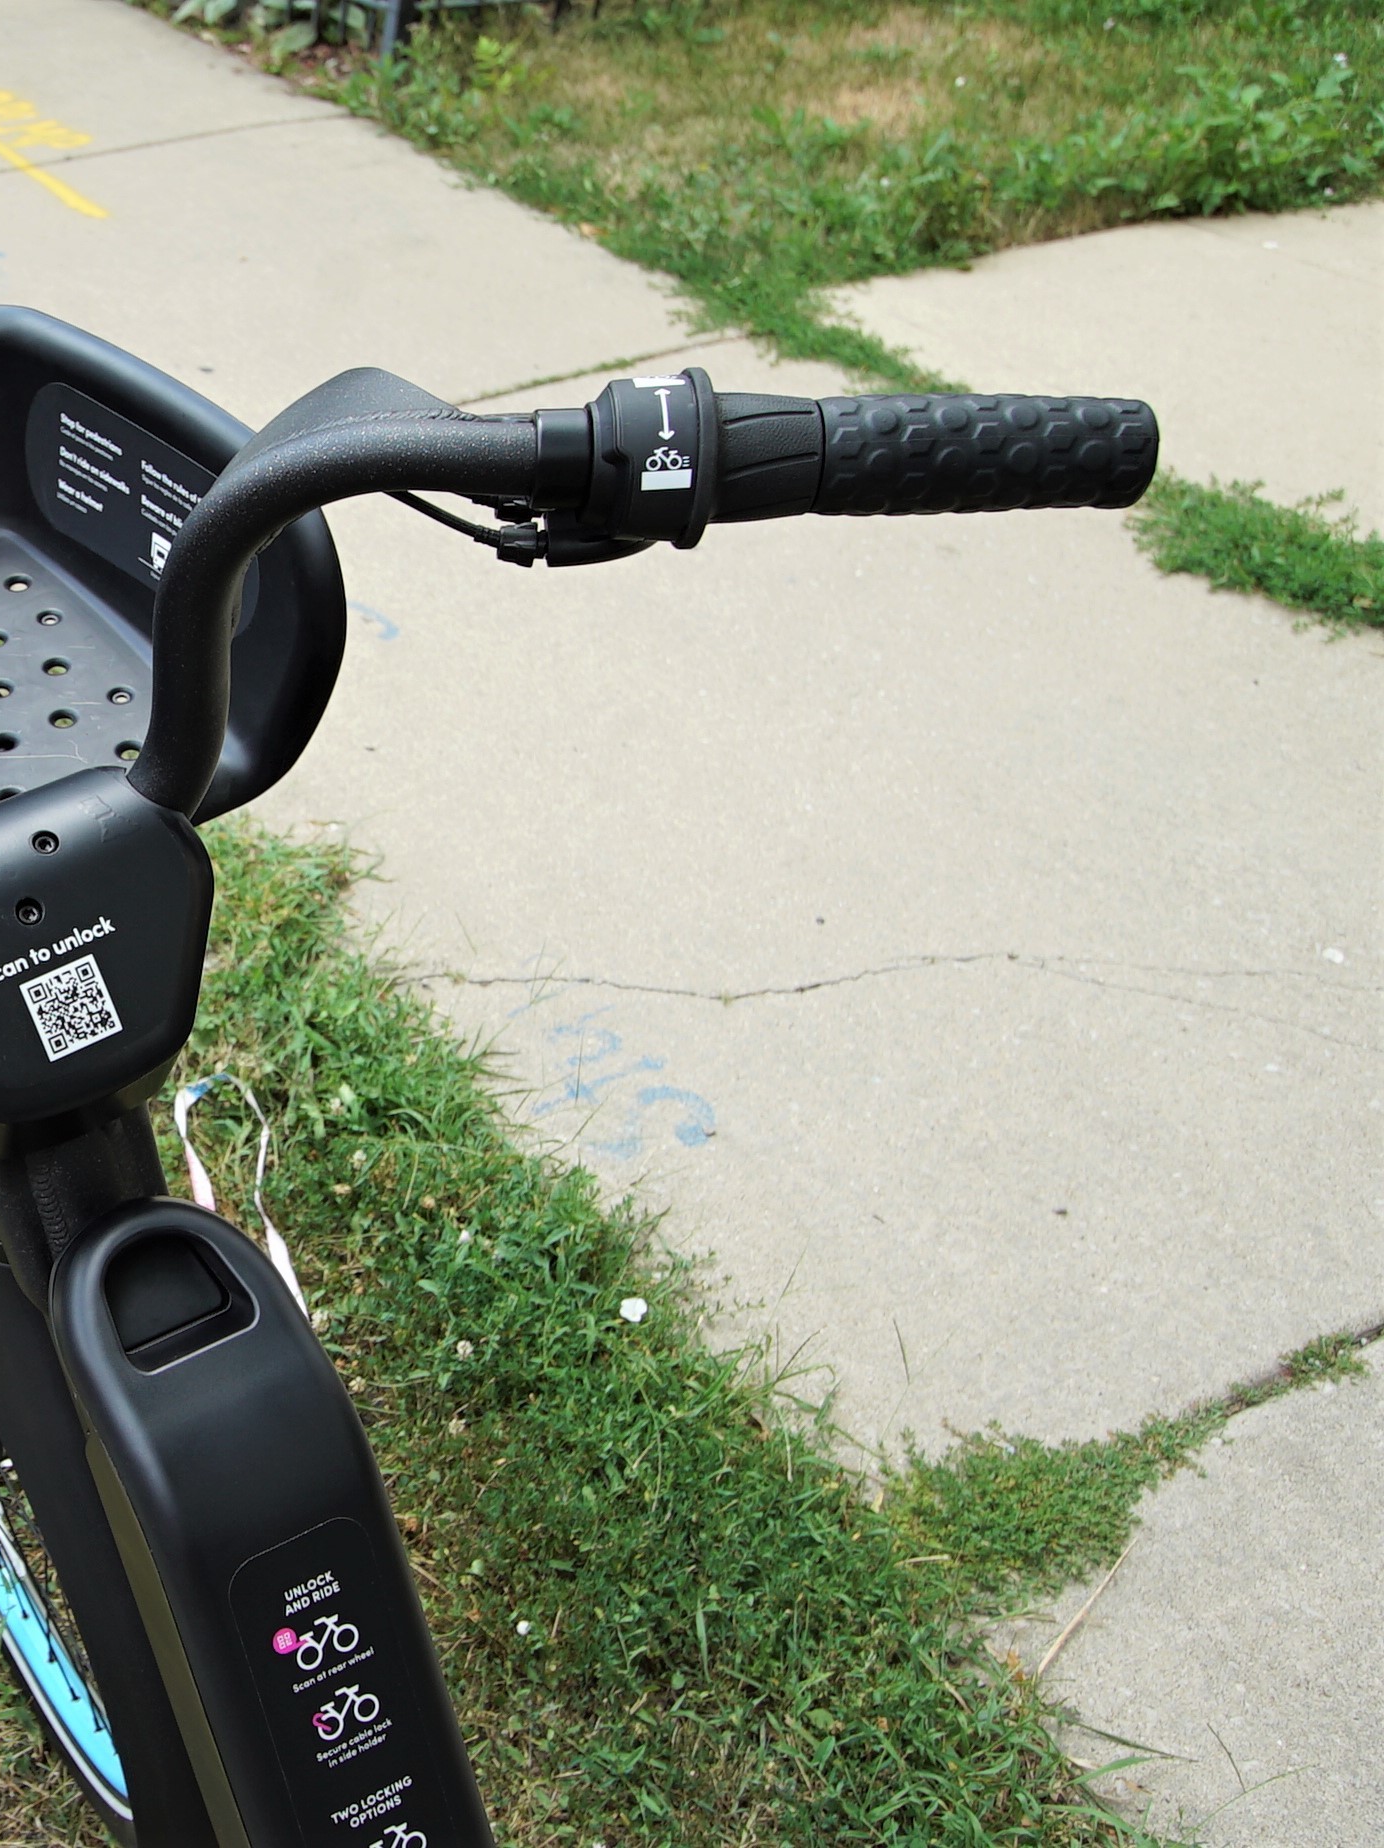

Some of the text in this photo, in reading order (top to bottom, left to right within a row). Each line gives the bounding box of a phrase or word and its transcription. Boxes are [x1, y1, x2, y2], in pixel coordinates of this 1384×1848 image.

[60, 413, 76, 430] Stop
[29, 947, 51, 966] to
[51, 916, 116, 956] unlock
[284, 1570, 335, 1602] UNLOCK
[285, 1580, 341, 1617] AND RIDE
[292, 1646, 375, 1693] Scan at rear wheel
[316, 1717, 393, 1762] Secure cable lock
[328, 1733, 387, 1768] in side holder
[330, 1775, 413, 1825] TWO LOCKING
[350, 1795, 402, 1829] OPTIONS
